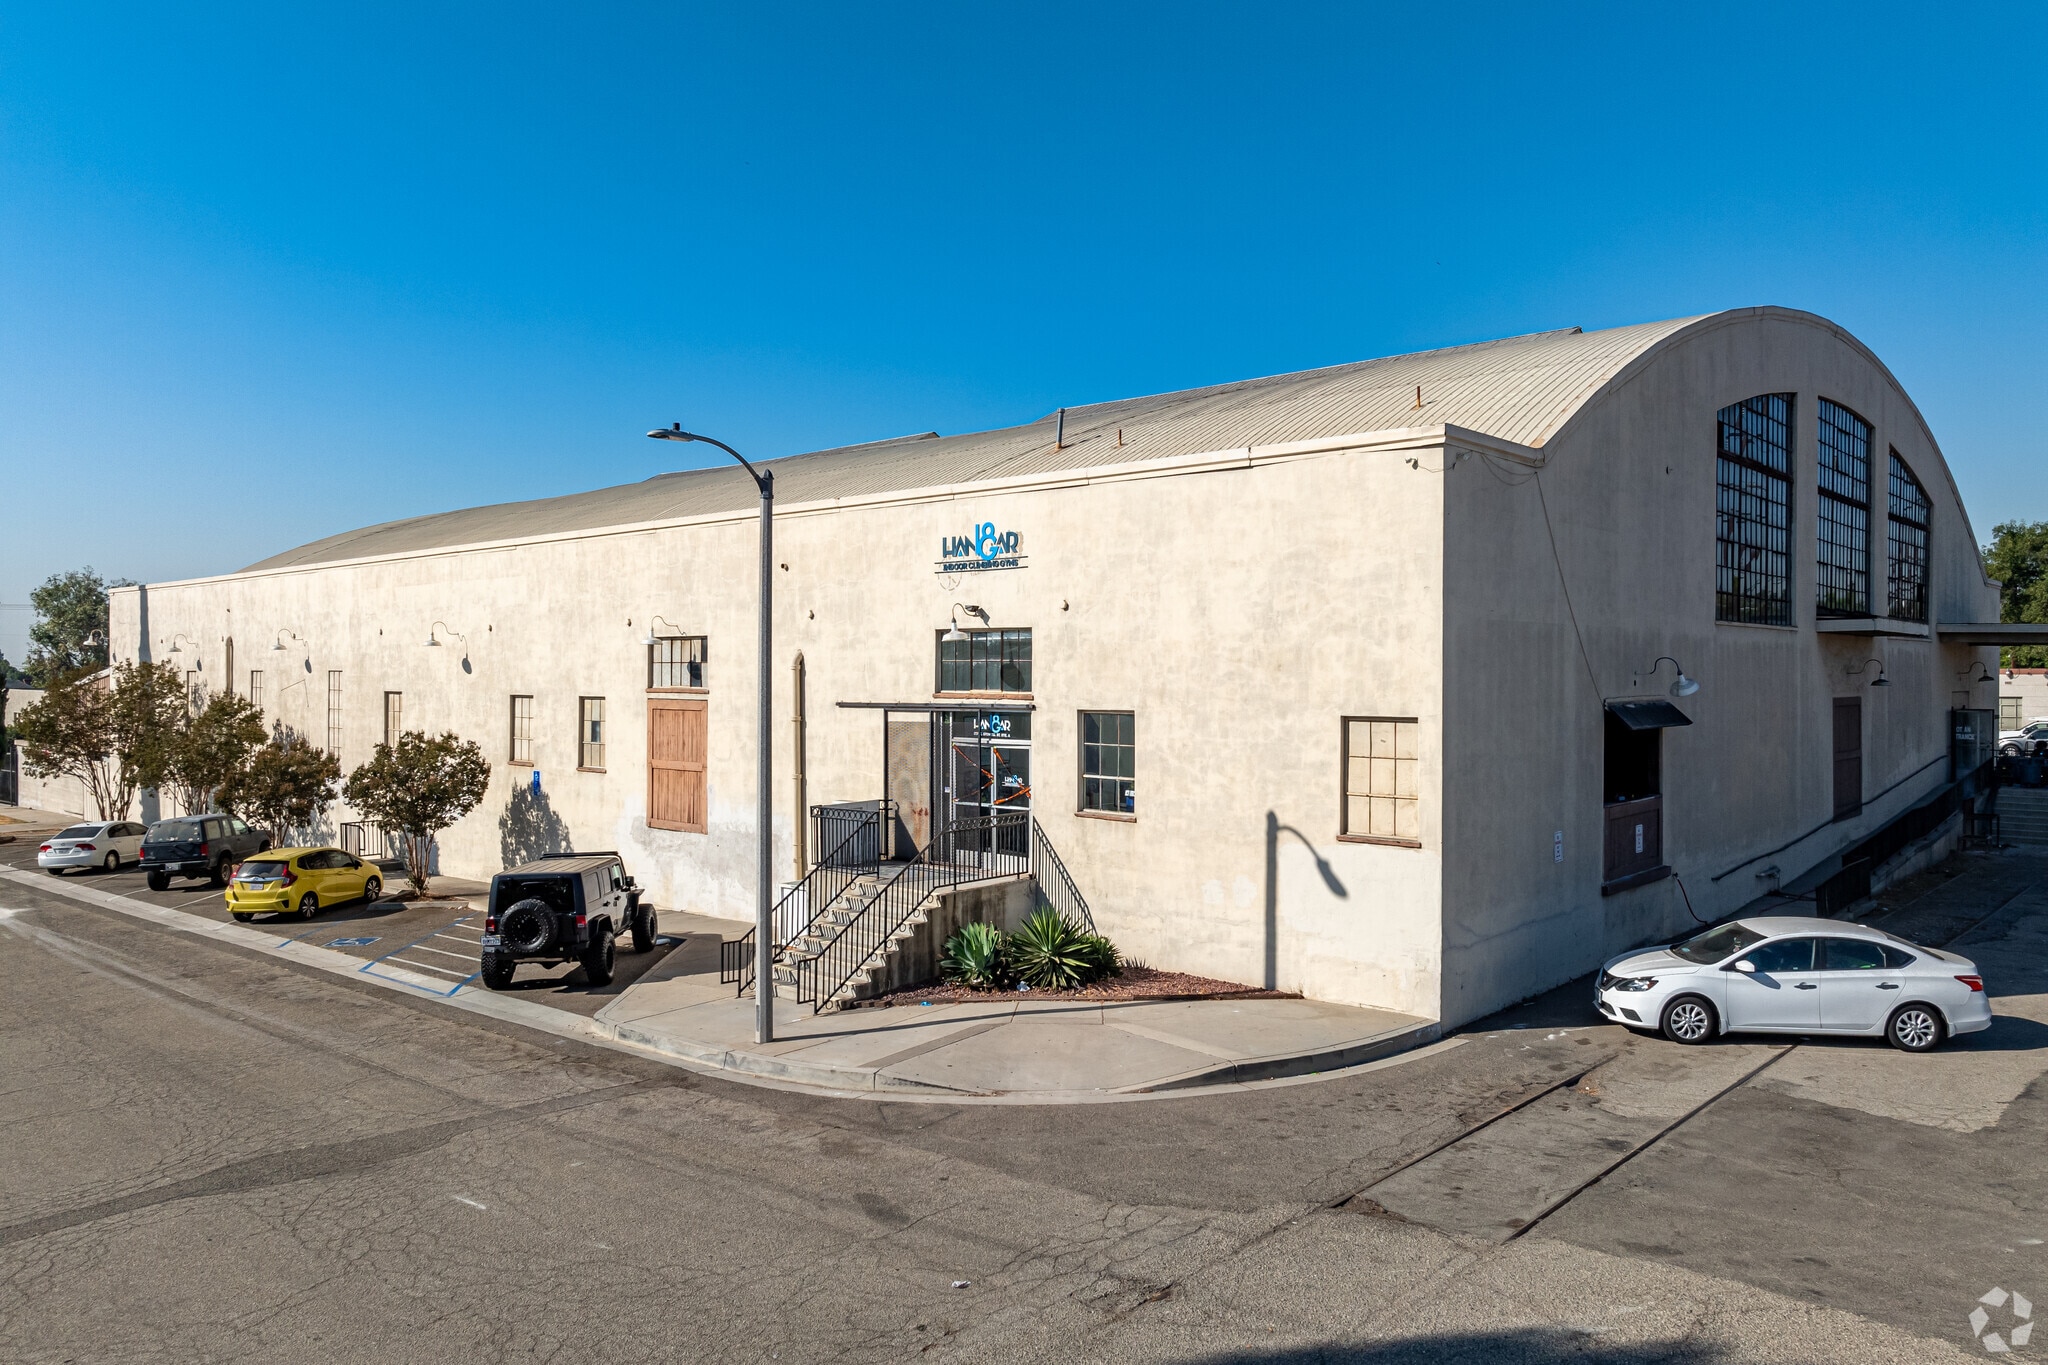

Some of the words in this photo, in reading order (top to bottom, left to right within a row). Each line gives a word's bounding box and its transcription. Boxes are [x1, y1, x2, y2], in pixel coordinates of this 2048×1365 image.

[943, 562, 968, 572] INDOOR
[968, 560, 999, 570] CLIMBING
[1000, 559, 1019, 568] GYMS
